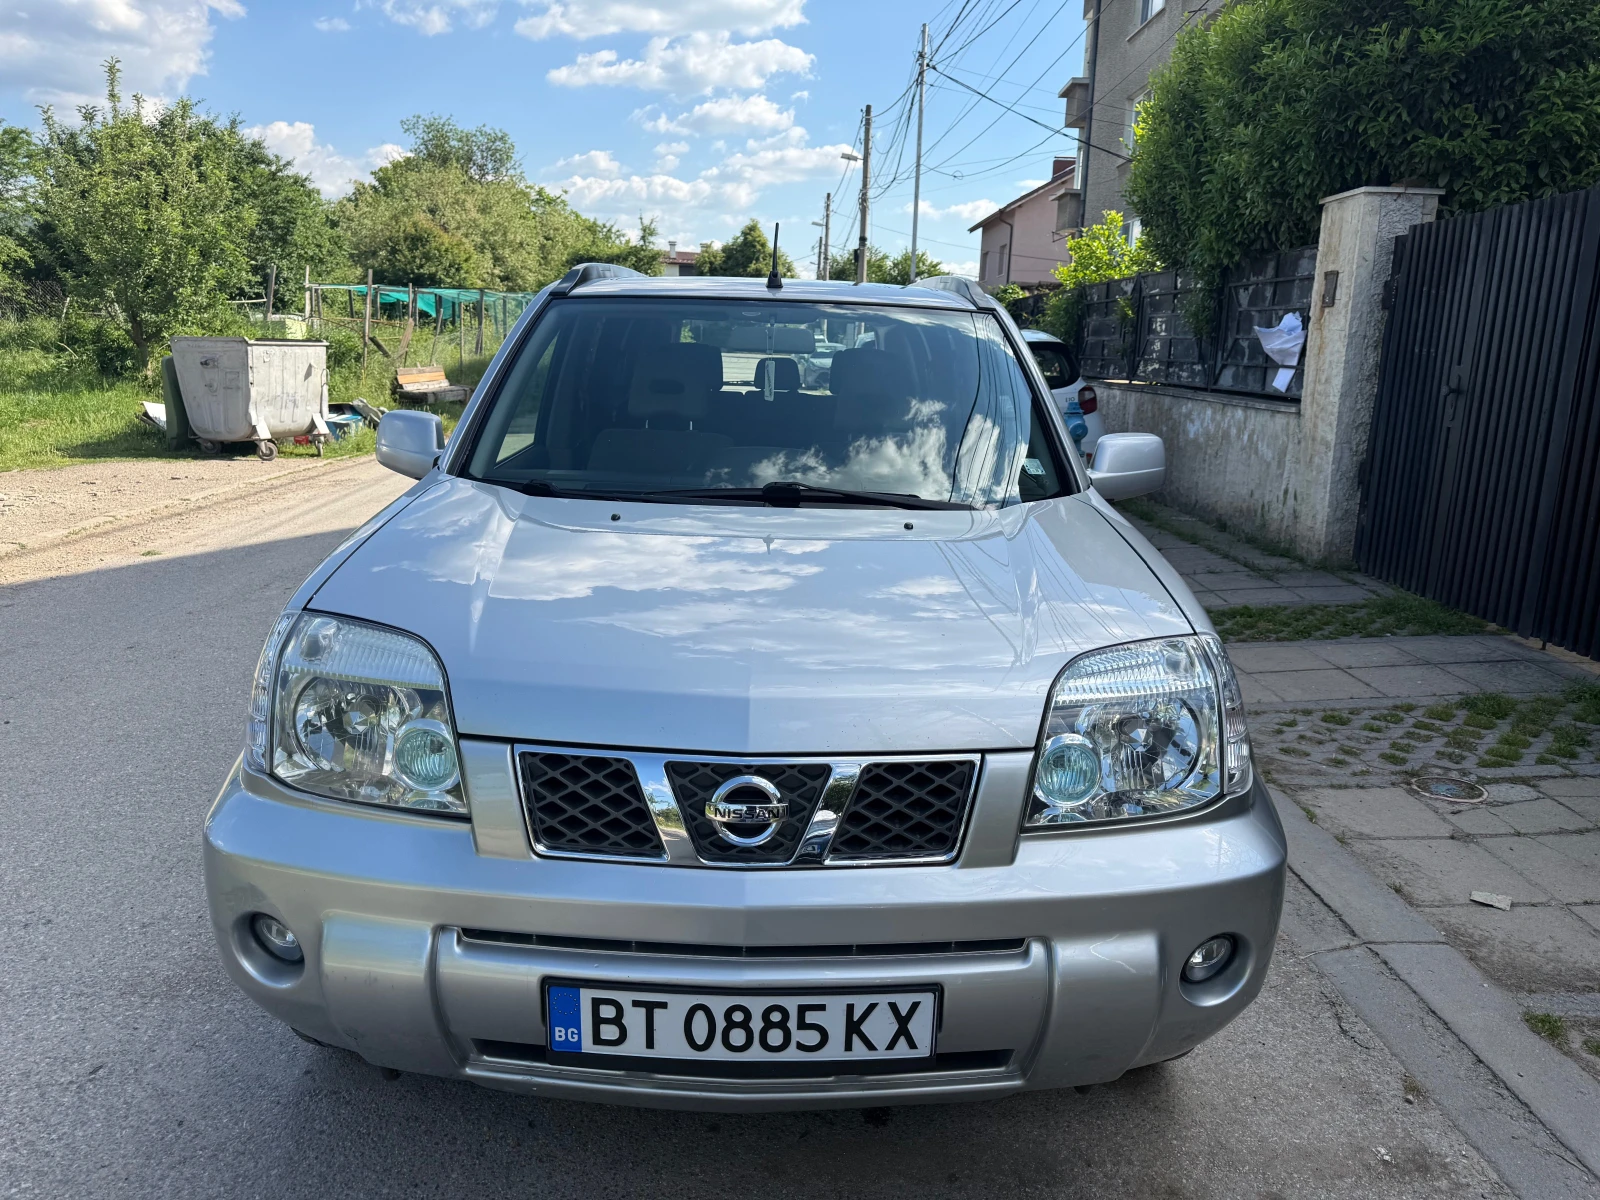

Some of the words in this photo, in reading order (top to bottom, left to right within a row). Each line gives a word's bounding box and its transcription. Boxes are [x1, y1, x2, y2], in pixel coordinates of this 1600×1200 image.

[714, 807, 780, 820] NISSAN
[591, 997, 668, 1050] BT
[684, 1003, 830, 1053] 0885
[844, 1001, 922, 1052] KX
[554, 1027, 579, 1042] BG
